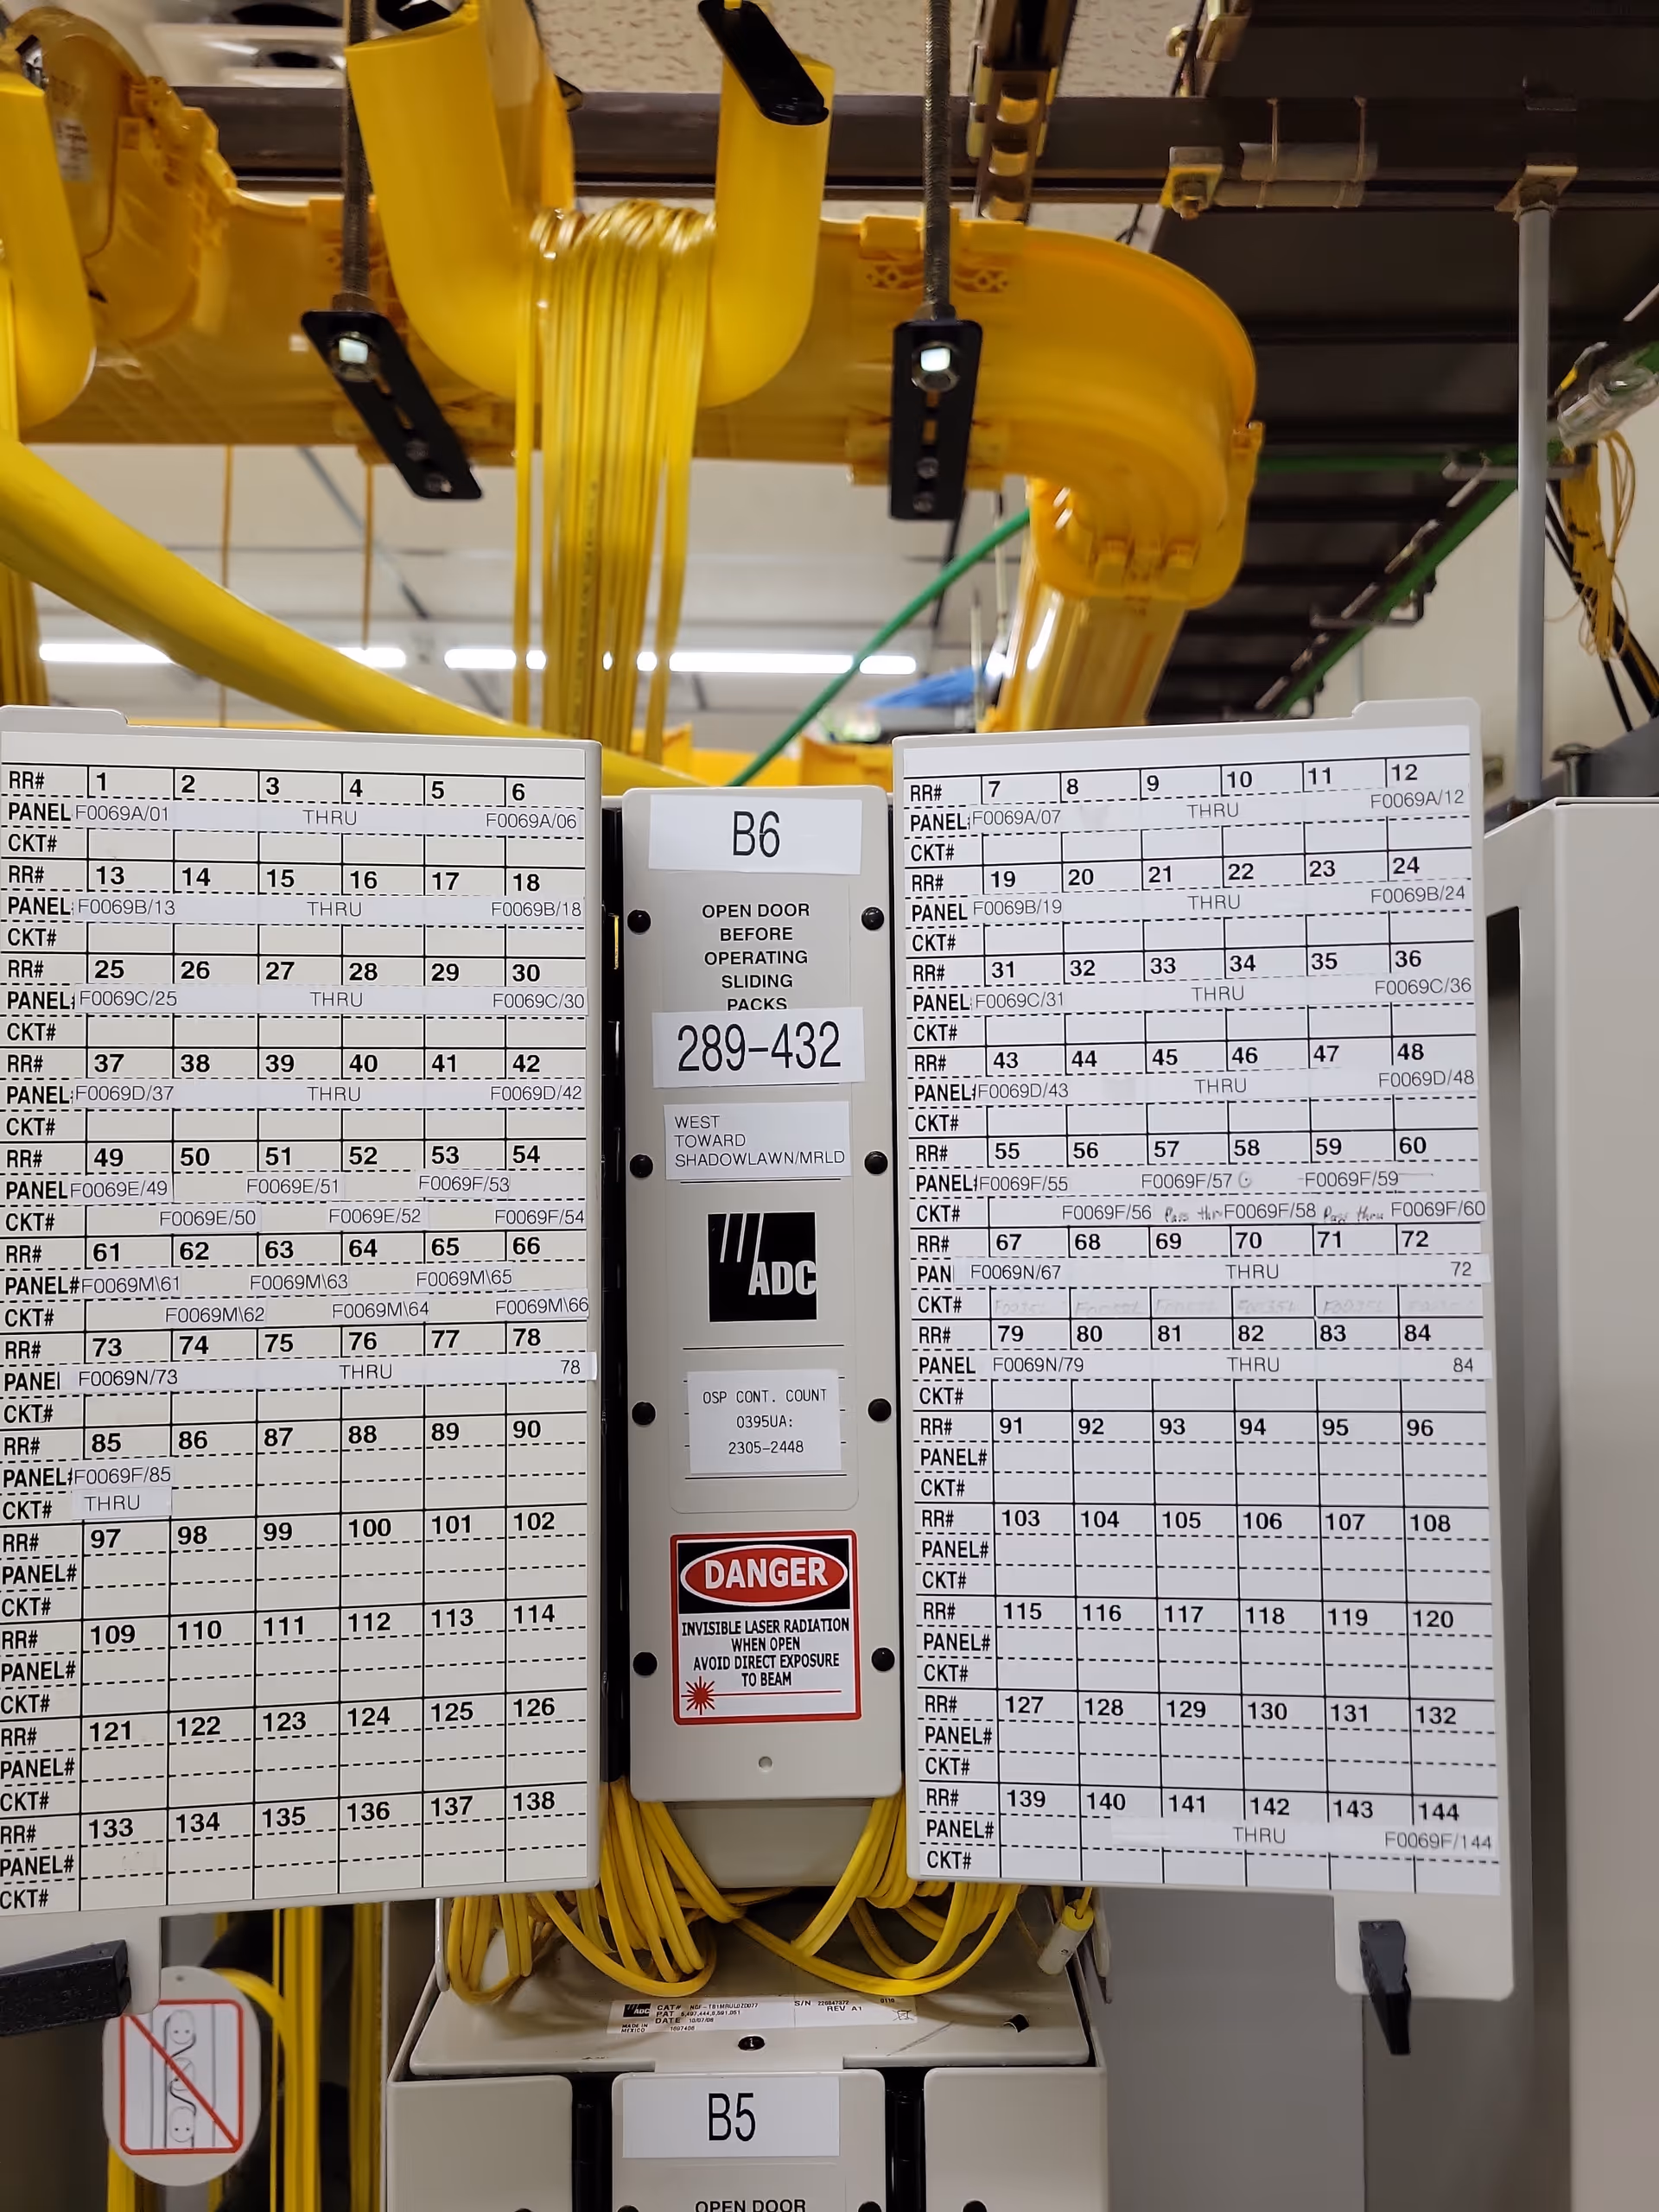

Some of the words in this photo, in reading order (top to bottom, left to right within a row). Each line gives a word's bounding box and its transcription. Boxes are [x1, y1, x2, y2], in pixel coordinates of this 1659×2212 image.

[10, 771, 44, 789] RR#
[97, 772, 105, 791] 1
[181, 775, 194, 792] 2
[266, 778, 279, 795] 3
[349, 779, 363, 797] 4
[432, 781, 444, 798] 5
[512, 784, 524, 801] 6
[911, 785, 942, 801] RR#
[988, 781, 1000, 797] 7
[1067, 779, 1078, 794] 8
[1147, 775, 1159, 791] 9
[1227, 772, 1252, 788] 10
[1308, 767, 1330, 785] 11
[1392, 764, 1417, 781] 12
[973, 810, 1060, 825] F0069A/07
[1186, 803, 1238, 818] THRU
[1371, 790, 1464, 809] F0069A/12
[76, 805, 167, 821] F0069A/01
[302, 810, 356, 825] THRU
[486, 813, 576, 829] F0069A/06
[734, 811, 779, 857] B6
[79, 899, 175, 915] F0069B/13
[307, 902, 361, 917] THRU
[493, 901, 581, 916] F0069B/18
[974, 899, 1061, 915] F0069B/19
[1188, 895, 1240, 910] THRU
[1371, 886, 1465, 903] F0069B/24
[702, 905, 751, 918] OPEN
[759, 904, 809, 917] DOOR
[721, 927, 792, 941] BEFORE
[705, 950, 807, 965] OPERATING
[722, 975, 792, 988] SLIDING
[80, 990, 176, 1006] F0069C/25
[310, 992, 362, 1007] THRU
[493, 994, 584, 1008] F0069C/30
[976, 992, 1062, 1008] F0069C/31
[1192, 986, 1243, 1001] THRU
[1376, 977, 1471, 995] F0069C/36
[728, 998, 788, 1010] PACKS
[678, 1021, 841, 1071] 289-432
[76, 1085, 174, 1101] F0069D/37
[307, 1087, 359, 1101] THRU
[492, 1085, 582, 1101] F0069D/42
[979, 1083, 1068, 1098] F0069D/43
[1194, 1078, 1246, 1093] THRU
[1379, 1070, 1474, 1087] F0069D/48
[675, 1116, 720, 1128] WEST
[674, 1134, 745, 1147] TOWARD
[676, 1151, 844, 1166] SHADOWLAWN/MRLD
[71, 1180, 167, 1198] F0069E/49
[247, 1179, 337, 1193] F0069E/51
[420, 1176, 509, 1192] F0069F/53
[980, 1176, 1067, 1191] F0069F/55
[1142, 1173, 1232, 1188] F0069F/57
[1306, 1171, 1398, 1186] F0069F/59
[161, 1210, 255, 1226] F0069E/50
[330, 1208, 420, 1224] F0069E/52
[496, 1209, 584, 1224] F0069F/54
[1063, 1205, 1151, 1220] F0069F/56
[1225, 1203, 1316, 1218] F0069F/58
[1392, 1201, 1485, 1217] F0069F/60
[7, 1245, 41, 1263] RR#
[93, 1243, 118, 1262] 61
[180, 1242, 208, 1260] 62
[265, 1241, 293, 1259] 63
[349, 1239, 378, 1257] 64
[432, 1237, 459, 1255] 65
[513, 1237, 540, 1255] 66
[918, 1236, 949, 1252] RR#
[996, 1234, 1021, 1250] 67
[1075, 1234, 1101, 1250] 68
[1156, 1233, 1181, 1249] 69
[1236, 1232, 1262, 1249] 70
[1318, 1231, 1340, 1248] 71
[1402, 1230, 1428, 1247] 72
[747, 1260, 817, 1296] ADC
[971, 1265, 1060, 1280] F0069N/67
[1225, 1264, 1278, 1279] THRU
[1451, 1262, 1471, 1276] 72
[82, 1276, 178, 1294] F0069M\61
[251, 1274, 347, 1290] F0069M\63
[417, 1269, 512, 1287] F0069M\65
[166, 1306, 264, 1323] F0069M\62
[333, 1301, 429, 1319] F0069M\64
[496, 1297, 589, 1319] F0069M\66
[79, 1370, 177, 1386] F0069N/73
[340, 1364, 391, 1379] THRU
[561, 1360, 580, 1374] 78
[994, 1357, 1084, 1372] F0069N/79
[1227, 1357, 1279, 1372] THRU
[1453, 1357, 1472, 1372] 84
[703, 1391, 727, 1403] OSP
[737, 1390, 775, 1403] CONT.
[786, 1389, 826, 1402] COUNT
[737, 1415, 791, 1428] 0395UA:
[729, 1440, 804, 1454] 2305-2448
[921, 1448, 987, 1465] PANEL#
[75, 1466, 170, 1484] F0069F/85
[84, 1495, 139, 1511] THRU
[703, 1556, 829, 1591] DANGER
[682, 1621, 741, 1636] INVISIBLE
[746, 1620, 780, 1634] LASER
[785, 1618, 849, 1633] RADIATION
[731, 1637, 766, 1652] WHEN
[770, 1637, 800, 1651] OPEN
[694, 1656, 730, 1671] AVOID
[734, 1655, 776, 1669] DIRECT
[780, 1653, 839, 1668] EXPOSURE
[741, 1673, 756, 1687] TO
[760, 1672, 791, 1686] BEAM
[927, 1788, 958, 1807] RR#
[1007, 1789, 1046, 1808] 139
[1087, 1792, 1125, 1810] 140
[1169, 1795, 1205, 1813] 141
[1250, 1797, 1289, 1815] 142
[1333, 1800, 1373, 1818] 143
[1419, 1802, 1459, 1821] 144
[1, 1824, 36, 1844] RR#
[89, 1818, 133, 1839] 133
[176, 1812, 219, 1833] 134
[263, 1807, 305, 1827] 135
[347, 1802, 390, 1821] 136
[431, 1796, 473, 1816] 137
[513, 1791, 555, 1811] 138
[1233, 1827, 1285, 1843] THRU
[1386, 1832, 1491, 1849] F0069F/144
[0, 1854, 73, 1877] PANEL#
[709, 2093, 755, 2141] B5
[695, 2200, 746, 2212] OPEN
[753, 2199, 806, 2212] DOOR
